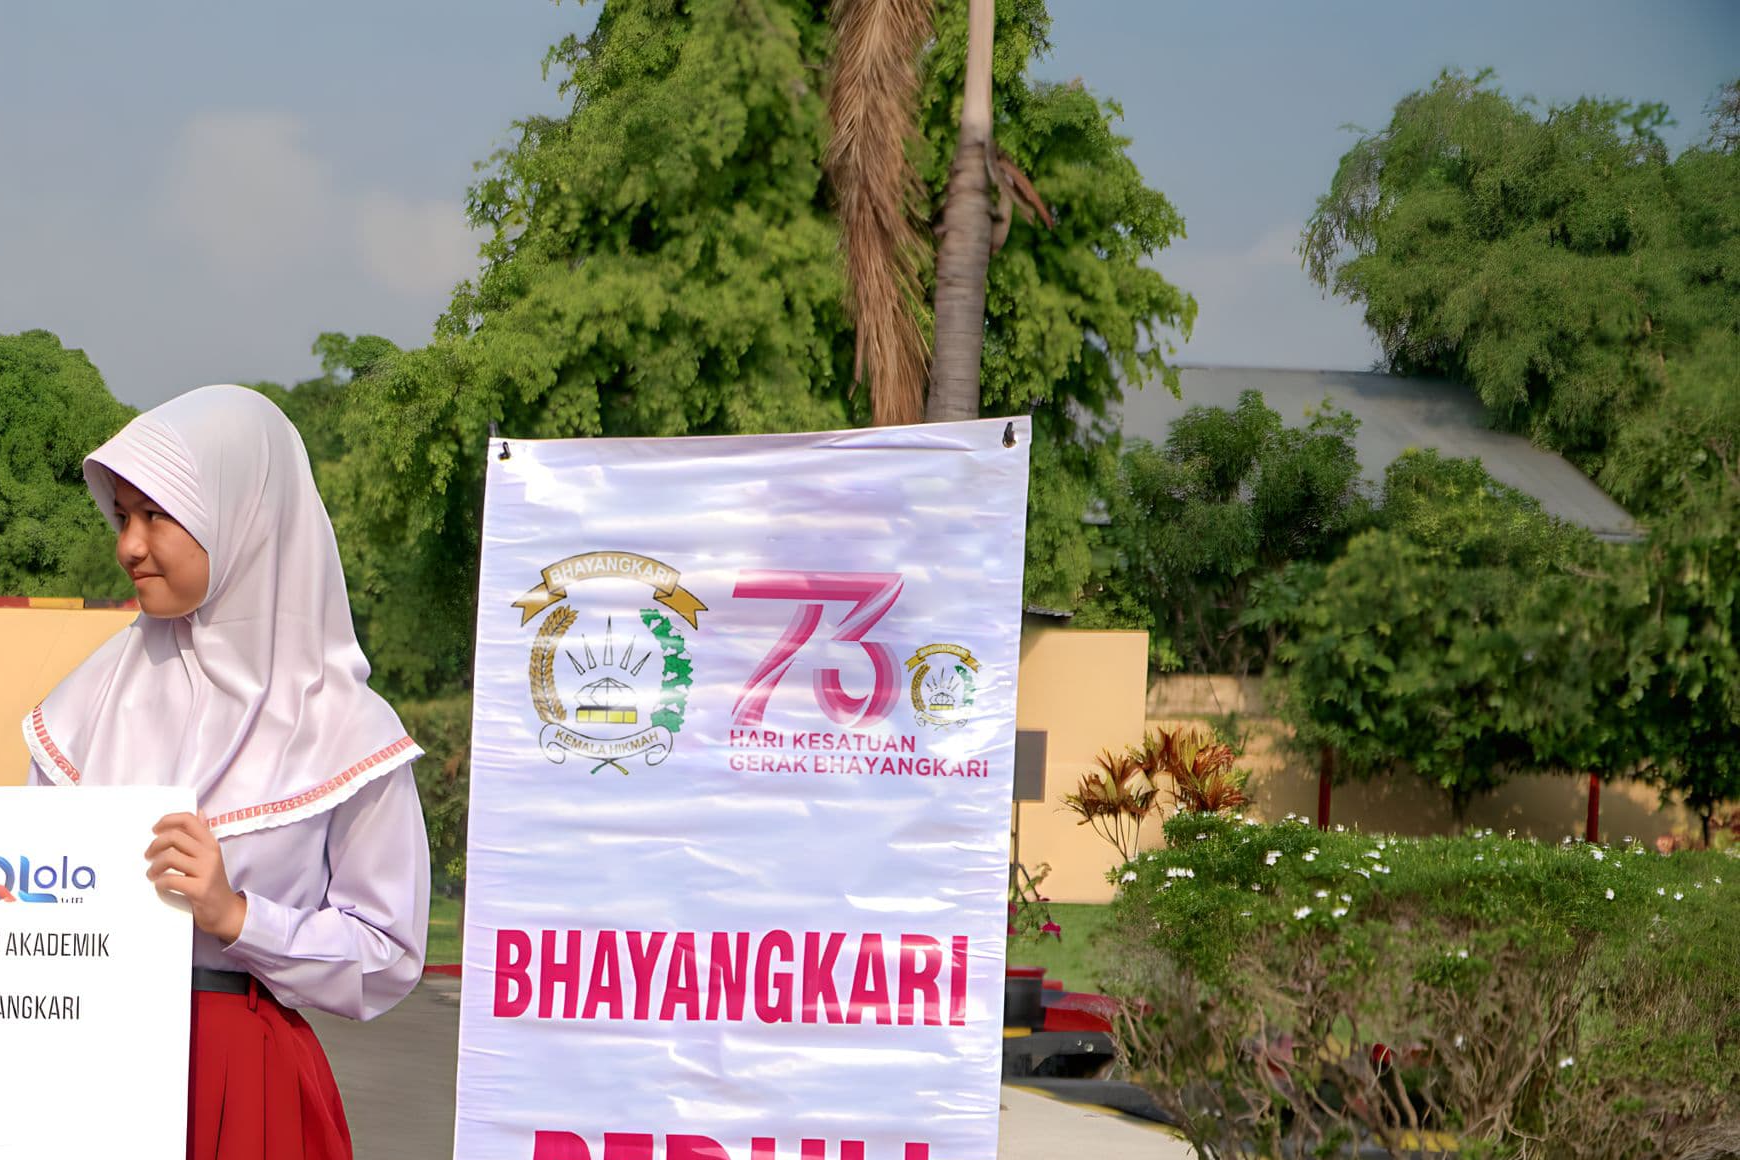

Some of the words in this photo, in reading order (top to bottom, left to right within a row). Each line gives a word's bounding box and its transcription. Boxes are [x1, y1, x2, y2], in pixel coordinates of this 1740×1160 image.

[549, 556, 671, 585] BHAYANGKARI
[732, 570, 904, 728] 73
[554, 729, 606, 755] KEMALA
[609, 731, 659, 755] HIKMAH
[730, 729, 783, 749] HARI
[793, 732, 916, 753] KESATUAN
[729, 753, 807, 774] GERAK
[814, 754, 989, 778] BHAYANGKARI
[5, 932, 110, 957] AKADEMIK
[493, 928, 969, 1026] BHAYANGKARI
